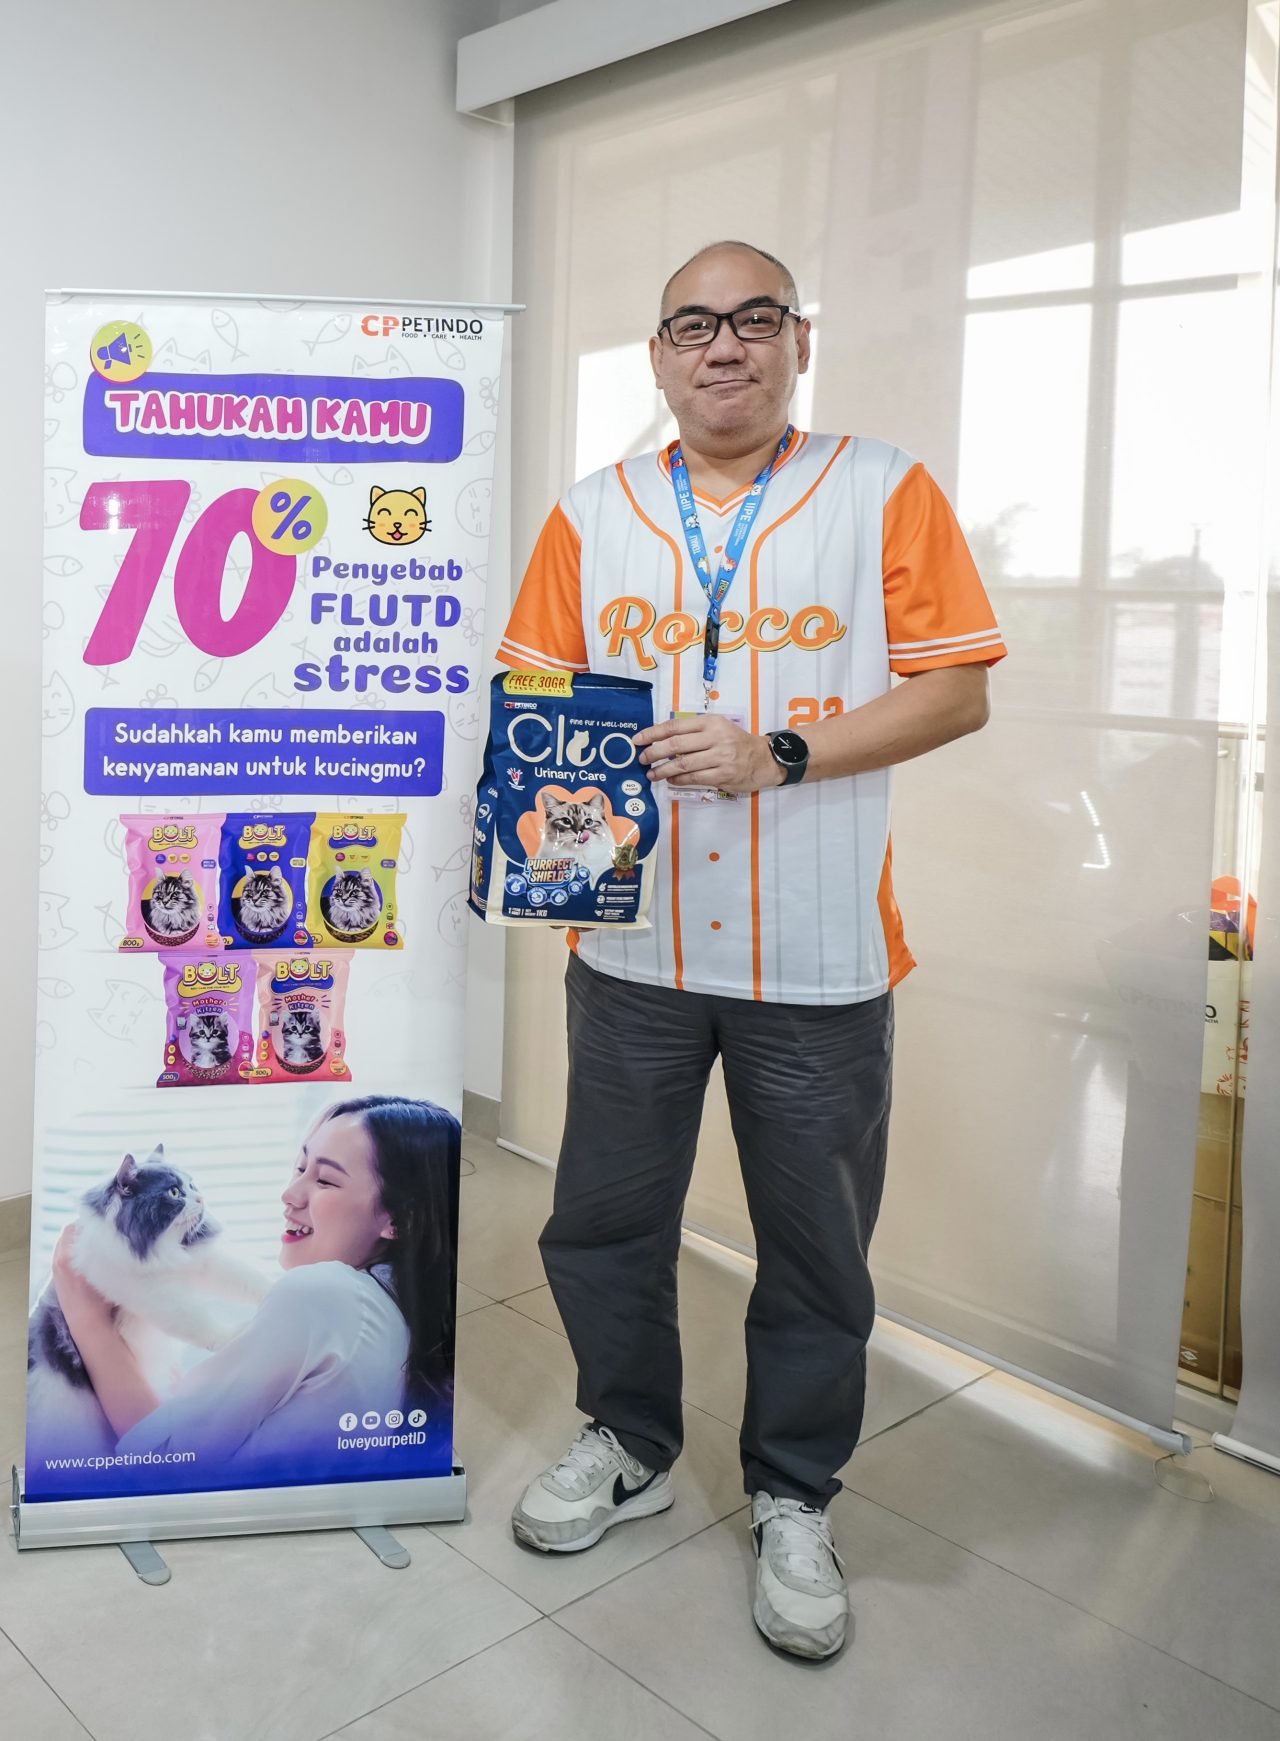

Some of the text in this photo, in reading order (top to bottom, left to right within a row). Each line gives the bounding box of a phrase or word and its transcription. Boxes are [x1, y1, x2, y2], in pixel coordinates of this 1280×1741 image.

[361, 314, 483, 337] CP PETINDO
[105, 390, 432, 444] TAHUKAH KAMU
[311, 555, 463, 585] Penyebab
[310, 592, 462, 628] FLUTD
[333, 631, 438, 653] adalah
[598, 596, 847, 671] Rocco
[293, 654, 470, 694] stress
[508, 674, 566, 690] FREE 30GR
[114, 722, 417, 746] Sudahkah kamu memberikan
[103, 756, 426, 783] kenyamanan untuk kucingmu?
[534, 766, 607, 782] Urinary Care
[152, 824, 196, 843] BOLT
[242, 823, 286, 841] BOLT
[332, 823, 376, 840] BOLT
[526, 858, 575, 871] PURRFECT
[183, 961, 240, 986] BOLT
[275, 958, 333, 981] BOLT
[337, 1431, 426, 1452] loveyourpetID
[45, 1449, 196, 1470] www.cppetindo.com
